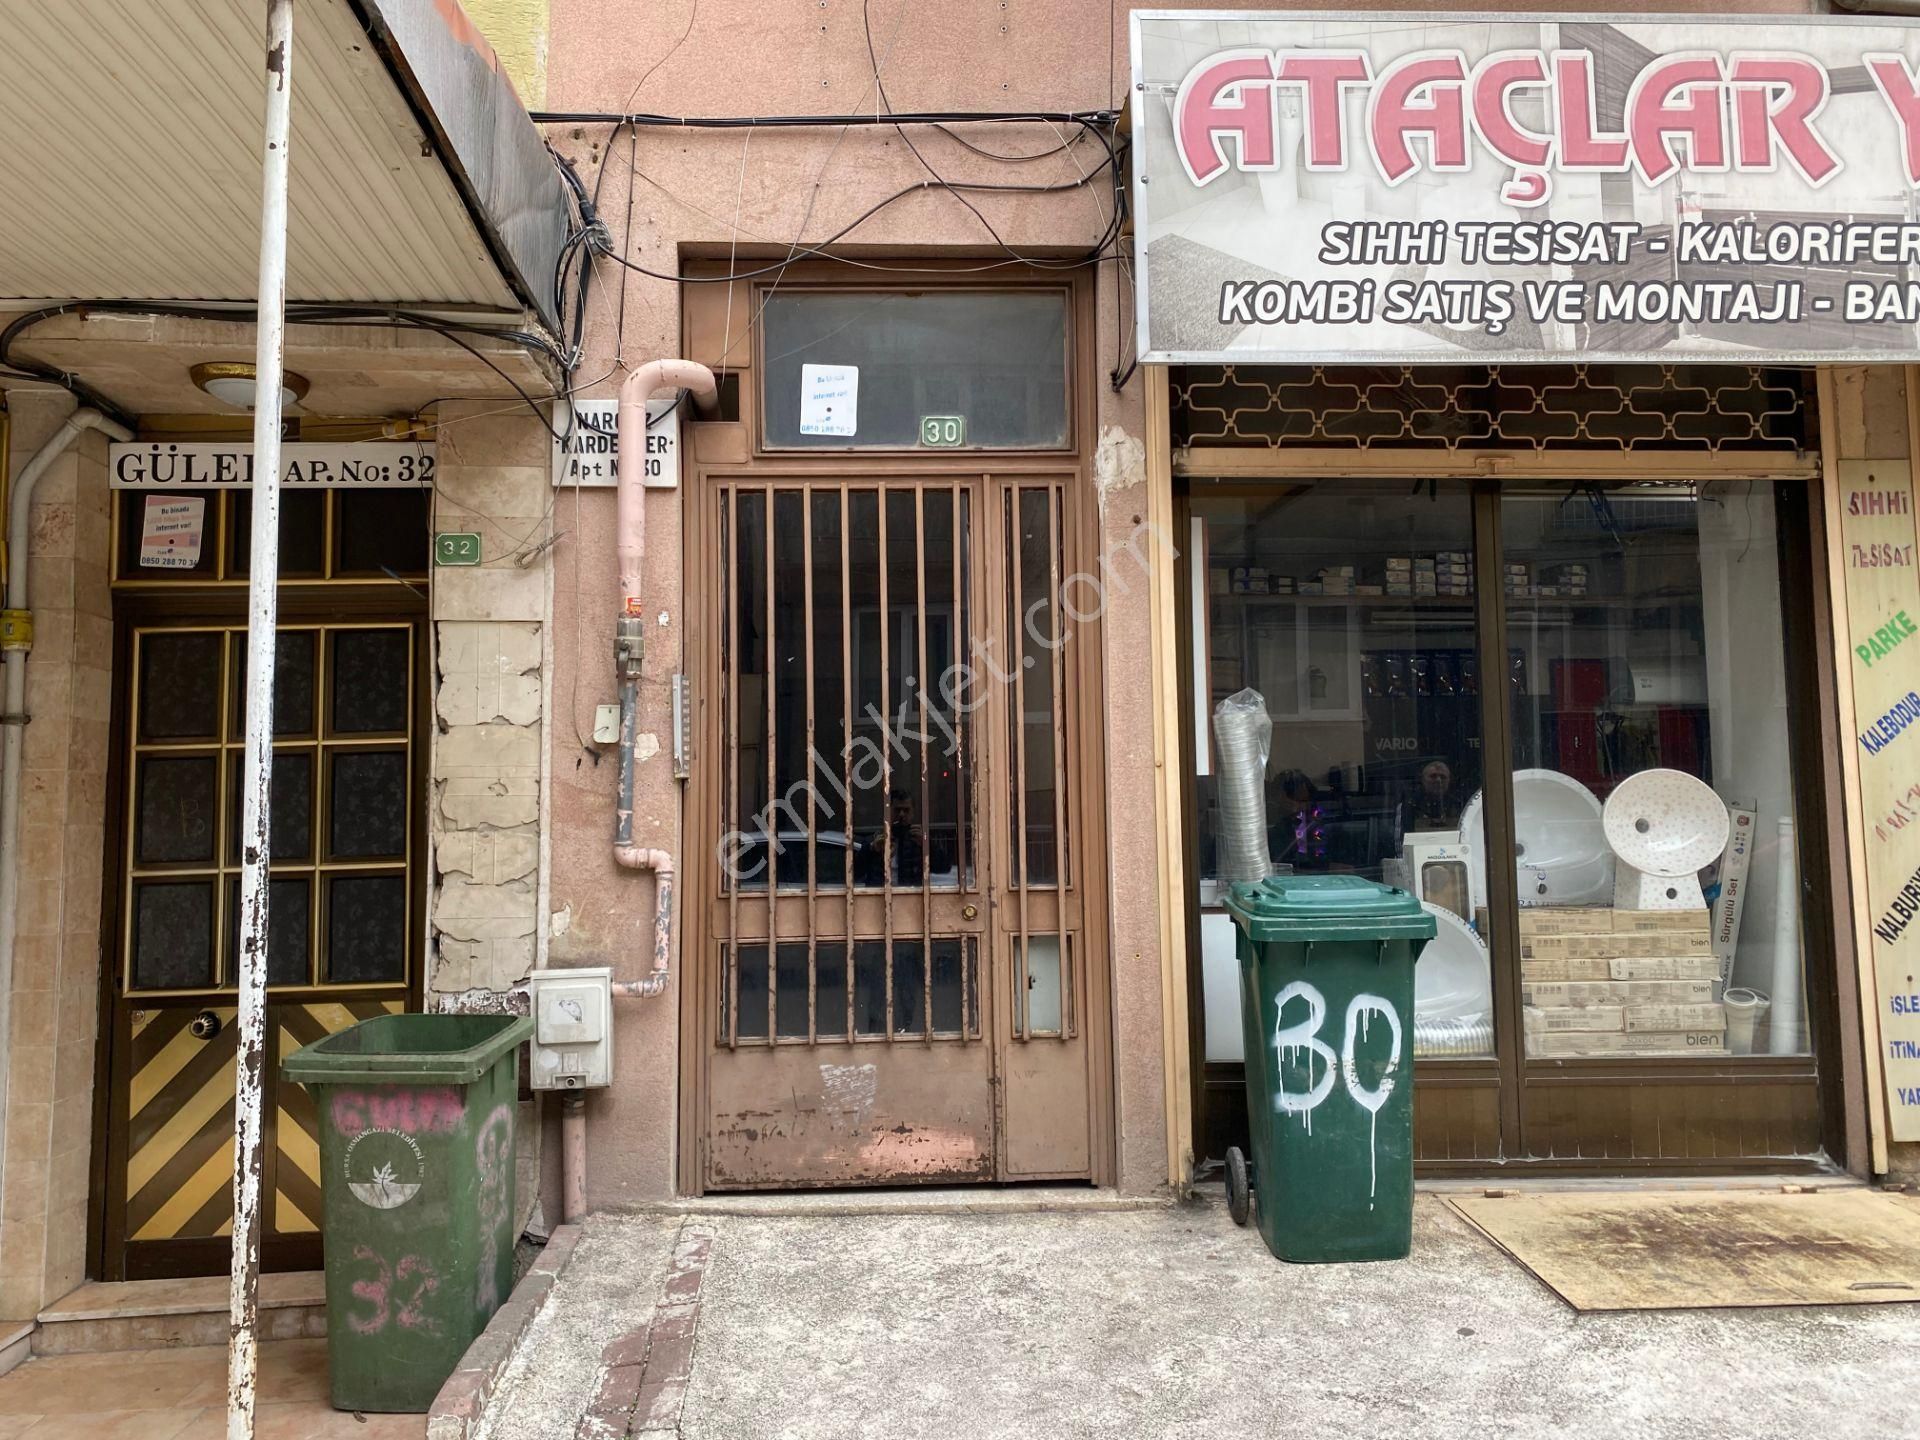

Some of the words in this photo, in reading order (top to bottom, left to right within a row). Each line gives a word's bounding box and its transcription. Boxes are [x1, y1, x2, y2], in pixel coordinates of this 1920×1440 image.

[1178, 51, 1842, 204] ATAÇLAR
[1382, 282, 1513, 334] SATIŞ
[1524, 282, 1587, 322] VE
[1597, 282, 1801, 323] MONTAJI
[1845, 282, 1920, 322] BA
[927, 421, 957, 443] 30
[561, 435, 668, 454] KARDEER
[570, 459, 602, 480] Apt
[155, 523, 179, 532] internet
[444, 541, 470, 555] 32
[1855, 610, 1918, 668] PARKE
[1727, 878, 1738, 896] Set
[1690, 938, 1710, 946] bien
[1692, 985, 1711, 993] bien
[1686, 1033, 1719, 1046] bien
